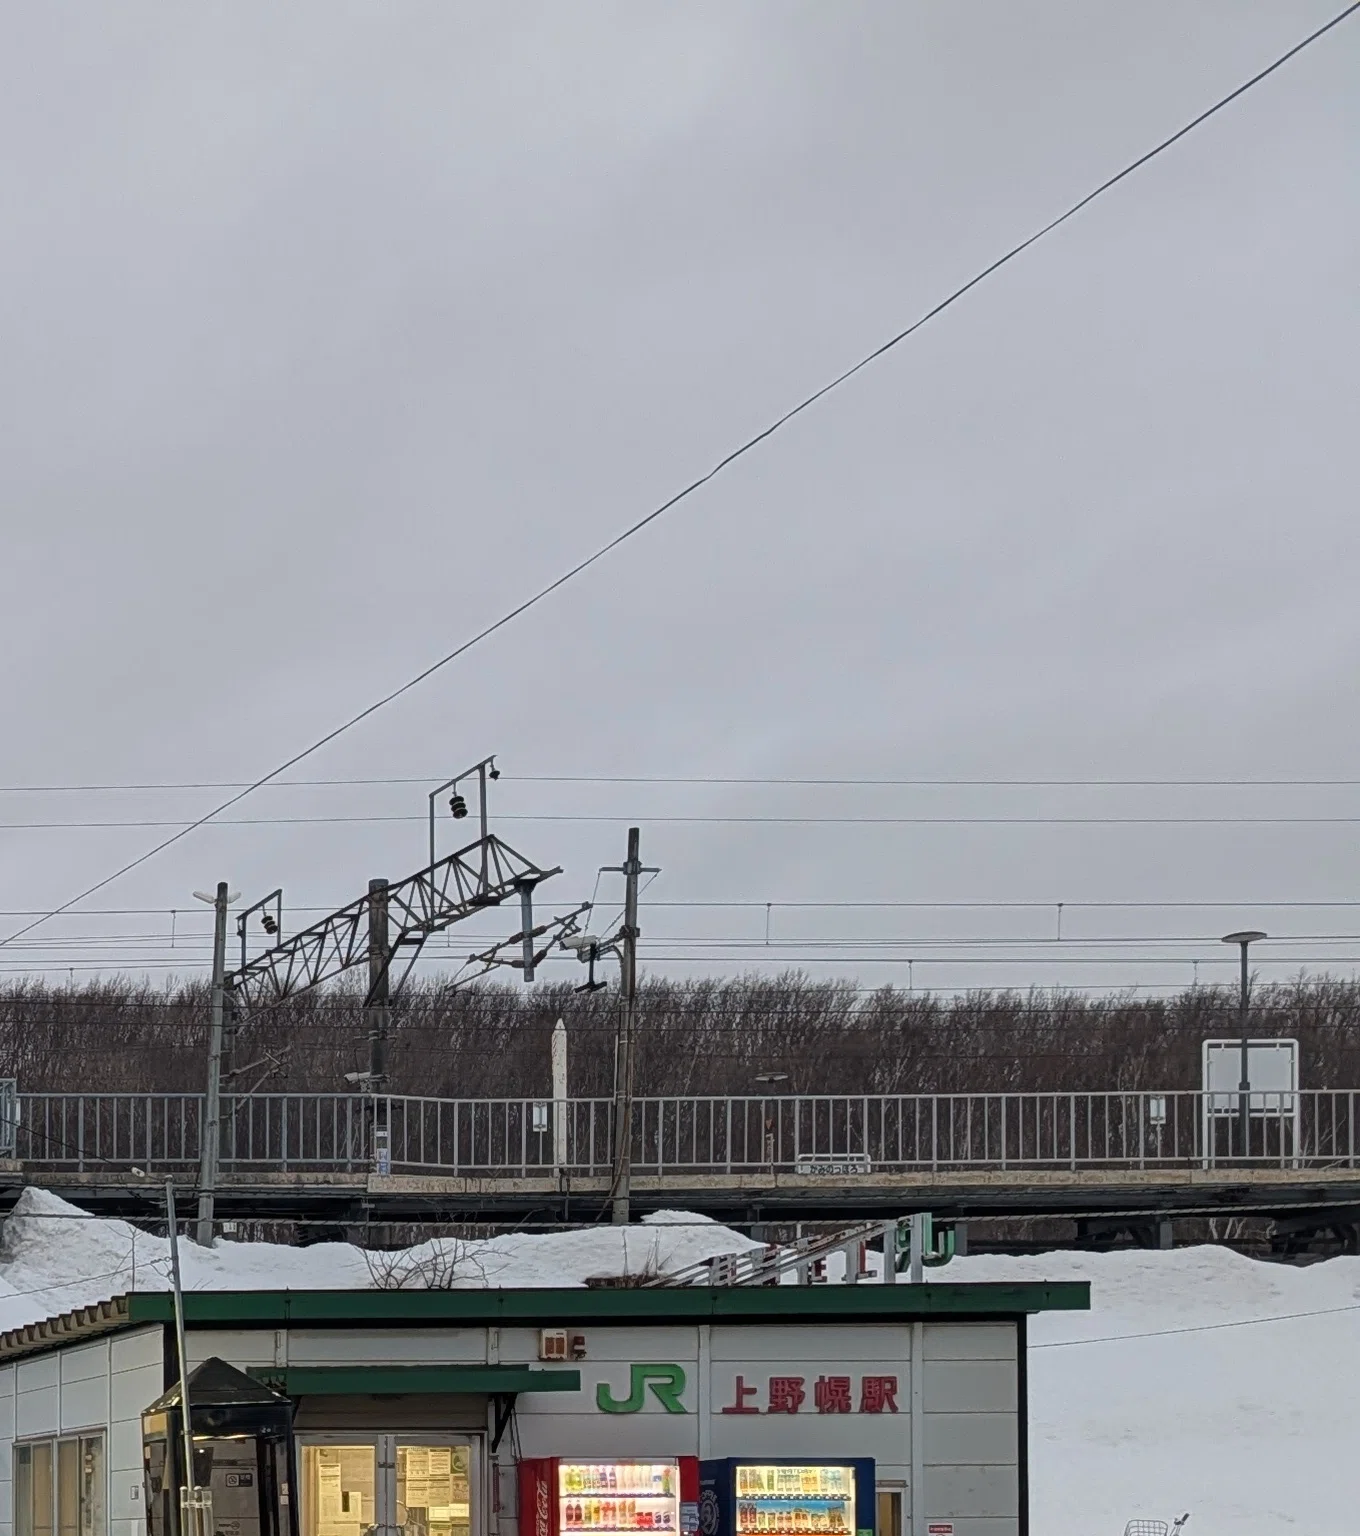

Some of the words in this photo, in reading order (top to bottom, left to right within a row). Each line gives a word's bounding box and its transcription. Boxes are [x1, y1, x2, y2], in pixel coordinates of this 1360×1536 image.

[596, 1364, 689, 1414] JR
[721, 1375, 899, 1415] 上野幌駅
